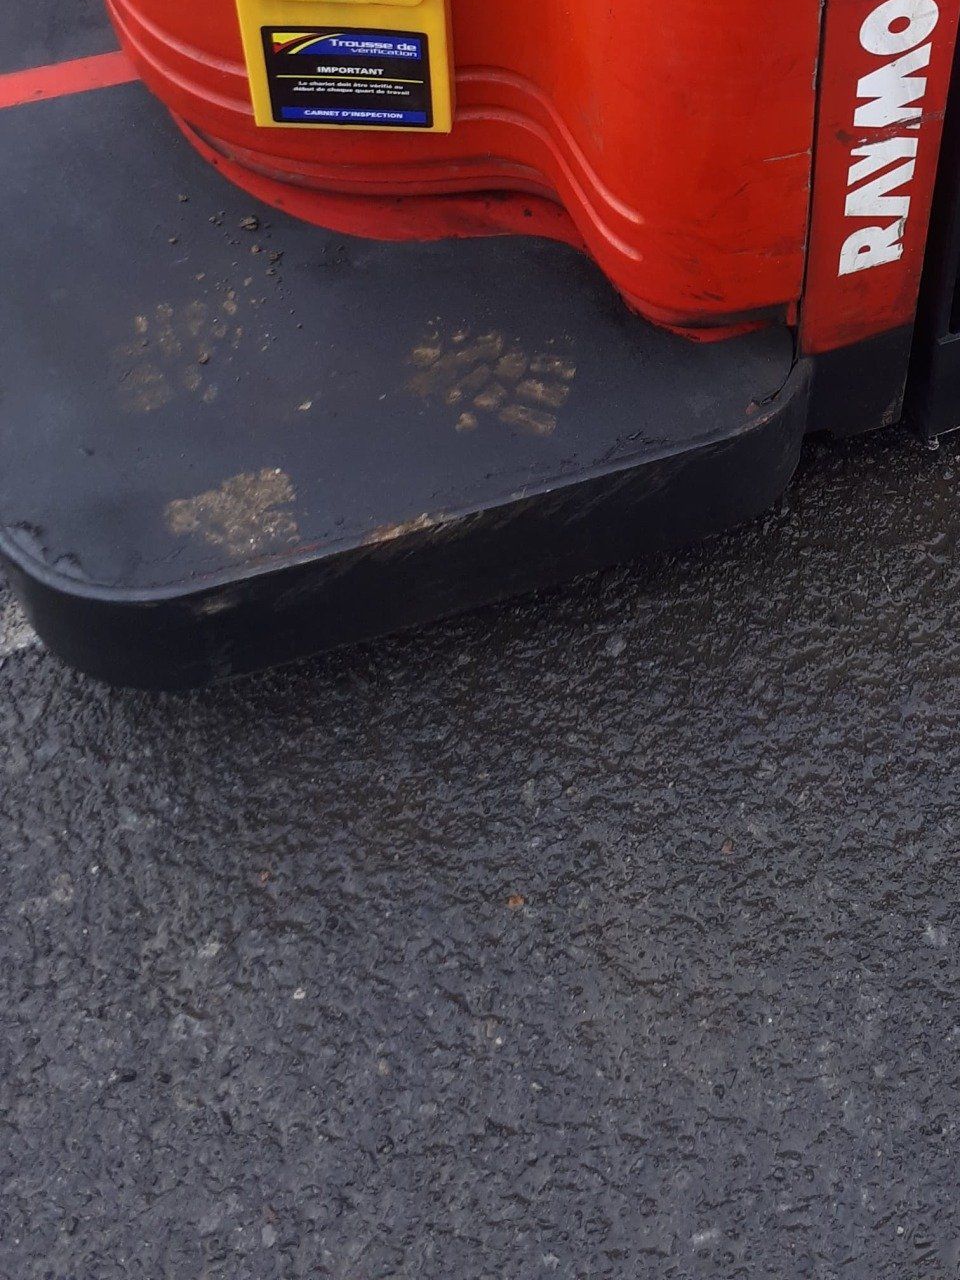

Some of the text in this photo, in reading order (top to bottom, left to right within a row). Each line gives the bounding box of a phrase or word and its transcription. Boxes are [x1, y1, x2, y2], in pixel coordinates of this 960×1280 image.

[329, 38, 416, 51] Trousse de
[350, 47, 418, 57] vérification
[317, 66, 385, 75] IMPORTANT
[304, 109, 403, 119] CARNET D'INSPECTION
